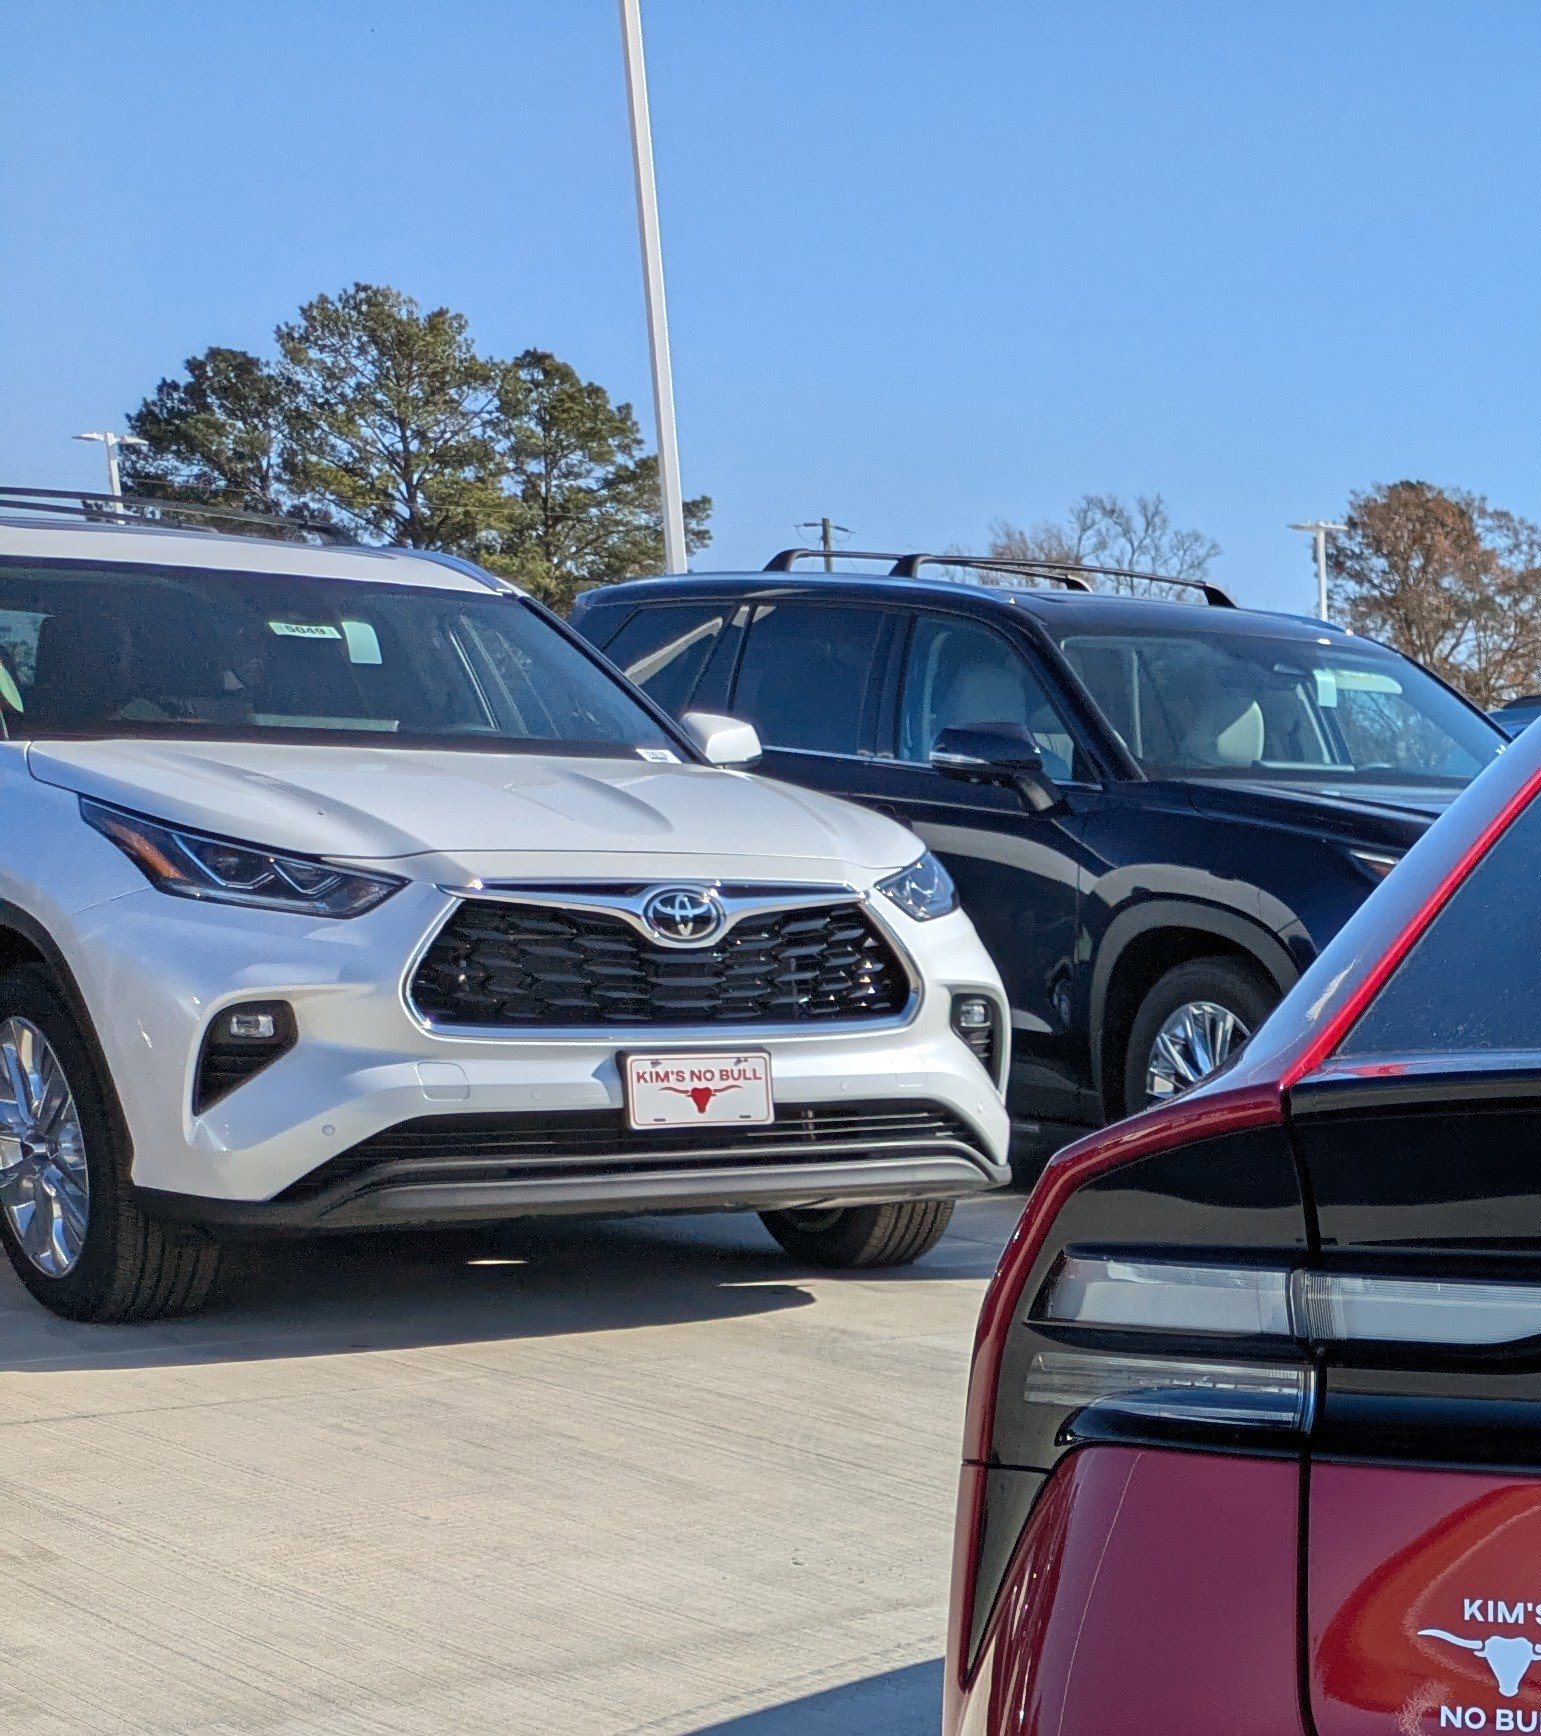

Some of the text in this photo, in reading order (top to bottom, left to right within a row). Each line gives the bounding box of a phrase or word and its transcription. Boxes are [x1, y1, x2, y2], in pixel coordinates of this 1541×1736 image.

[636, 1068, 762, 1083] KIM'S NO BULL
[1439, 1704, 1487, 1731] NO
